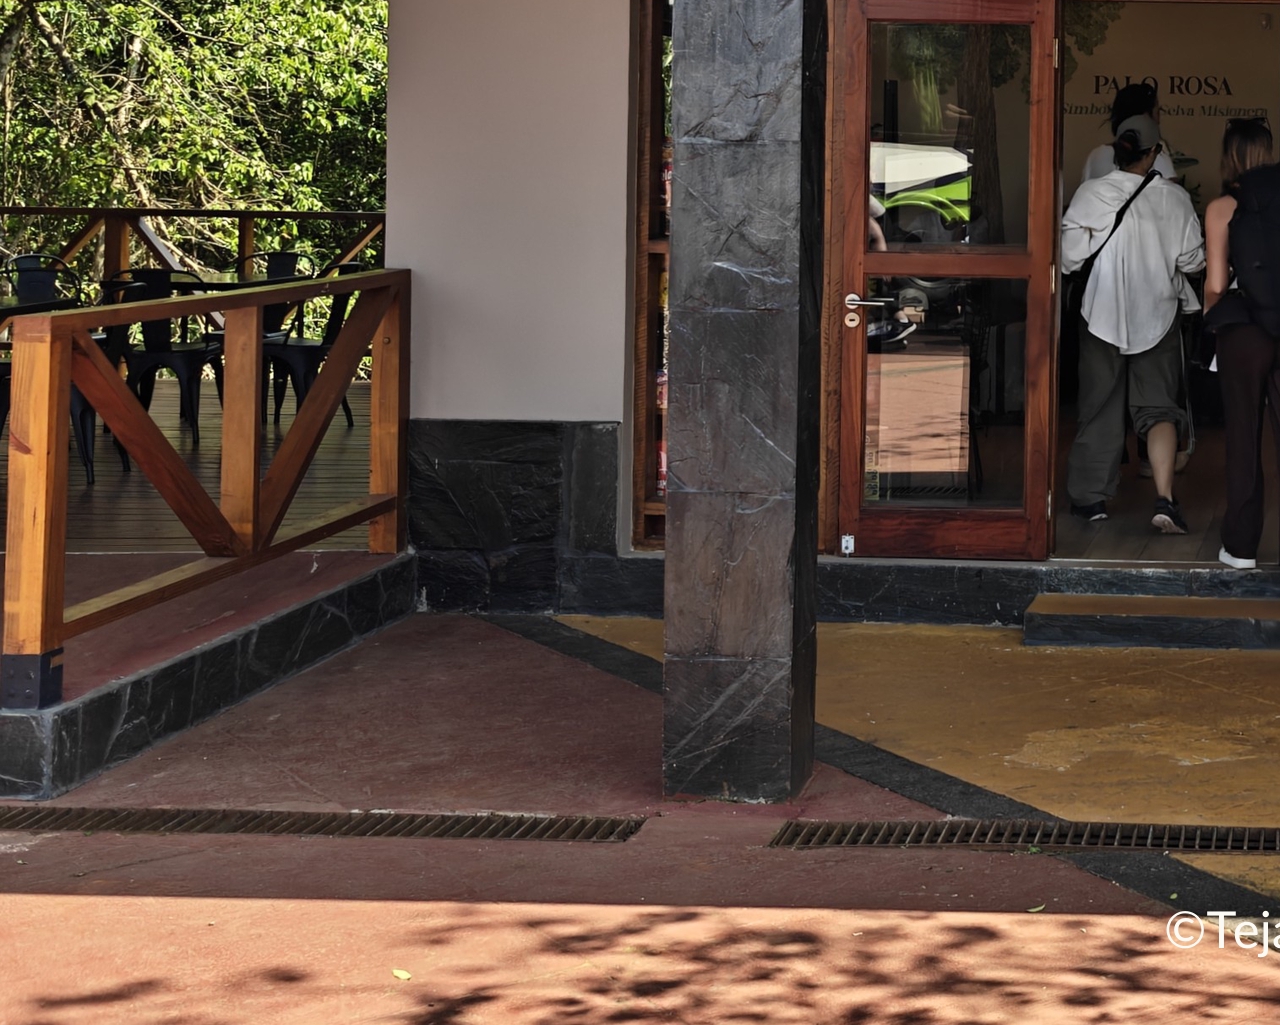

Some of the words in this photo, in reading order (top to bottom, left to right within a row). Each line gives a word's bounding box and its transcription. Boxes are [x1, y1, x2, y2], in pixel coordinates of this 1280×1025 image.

[1169, 75, 1232, 96] ROSA
[1158, 104, 1195, 116] Selva
[1201, 105, 1268, 118] Misionera
